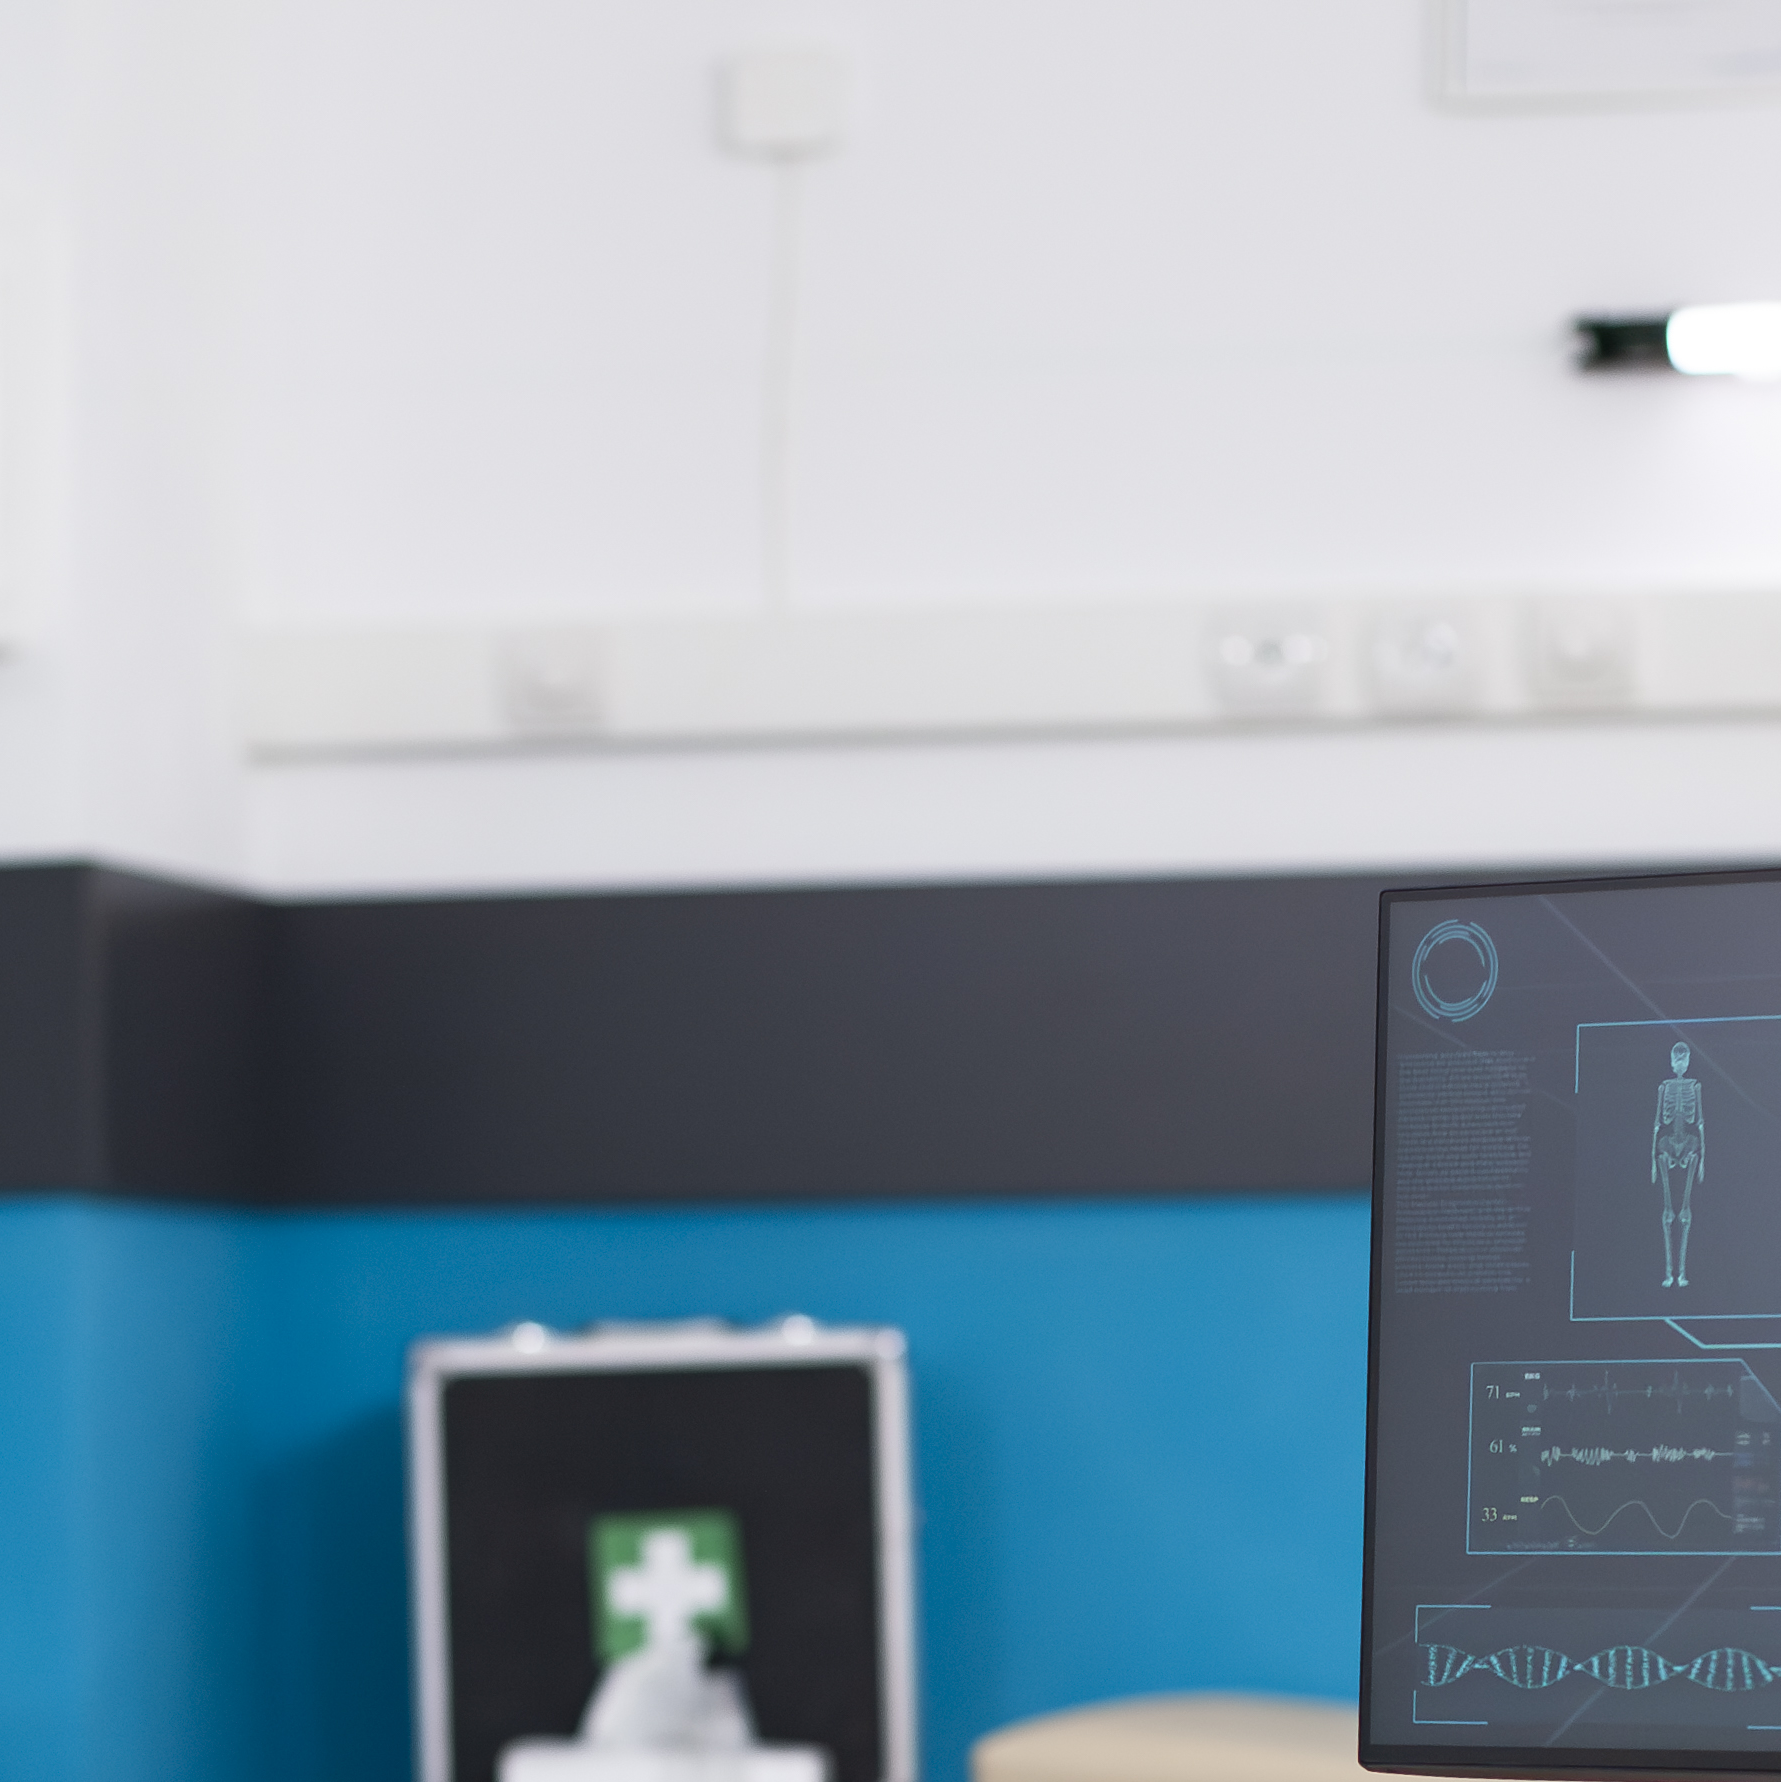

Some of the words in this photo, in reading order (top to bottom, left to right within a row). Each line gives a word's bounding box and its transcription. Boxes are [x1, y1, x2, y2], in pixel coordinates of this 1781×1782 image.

[1485, 1385, 1500, 1399] 71
[1489, 1439, 1503, 1454] 61
[1481, 1507, 1498, 1522] 33
